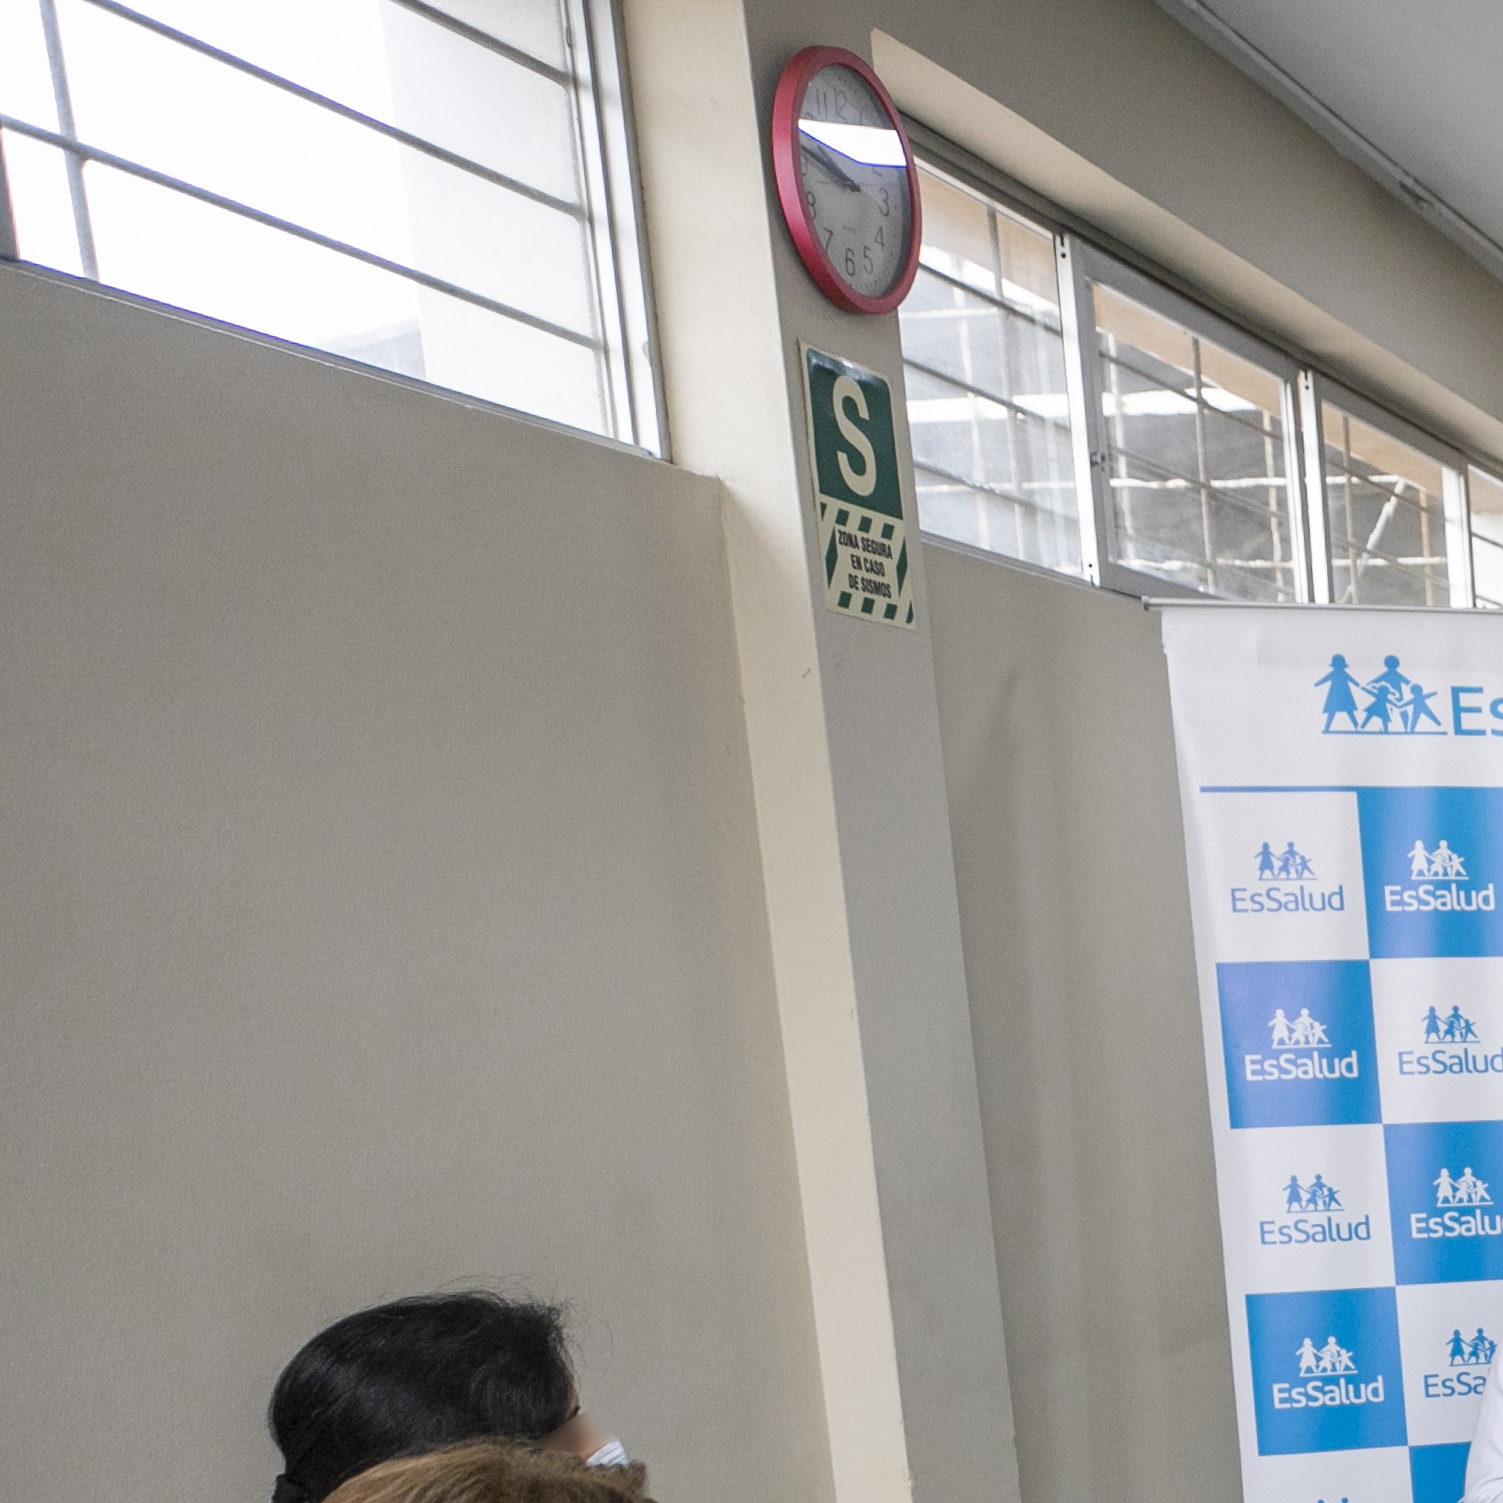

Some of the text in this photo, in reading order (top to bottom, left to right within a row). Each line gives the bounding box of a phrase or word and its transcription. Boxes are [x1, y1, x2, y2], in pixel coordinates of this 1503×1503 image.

[874, 225, 886, 252] 4
[844, 247, 855, 277] 6
[863, 246, 874, 275] 5
[832, 374, 877, 497] S
[837, 529, 893, 560] ZONA SEGURA
[850, 552, 886, 578] EN CASO
[848, 572, 892, 600] DE SISMOS
[1230, 884, 1345, 913] EsSalud
[1384, 881, 1495, 913] EsSalud
[1244, 1048, 1360, 1083] EsSalud
[1259, 1214, 1371, 1246] EsSalud
[1272, 1374, 1385, 1410] EsSalud
[1423, 1371, 1487, 1398] EsSa
